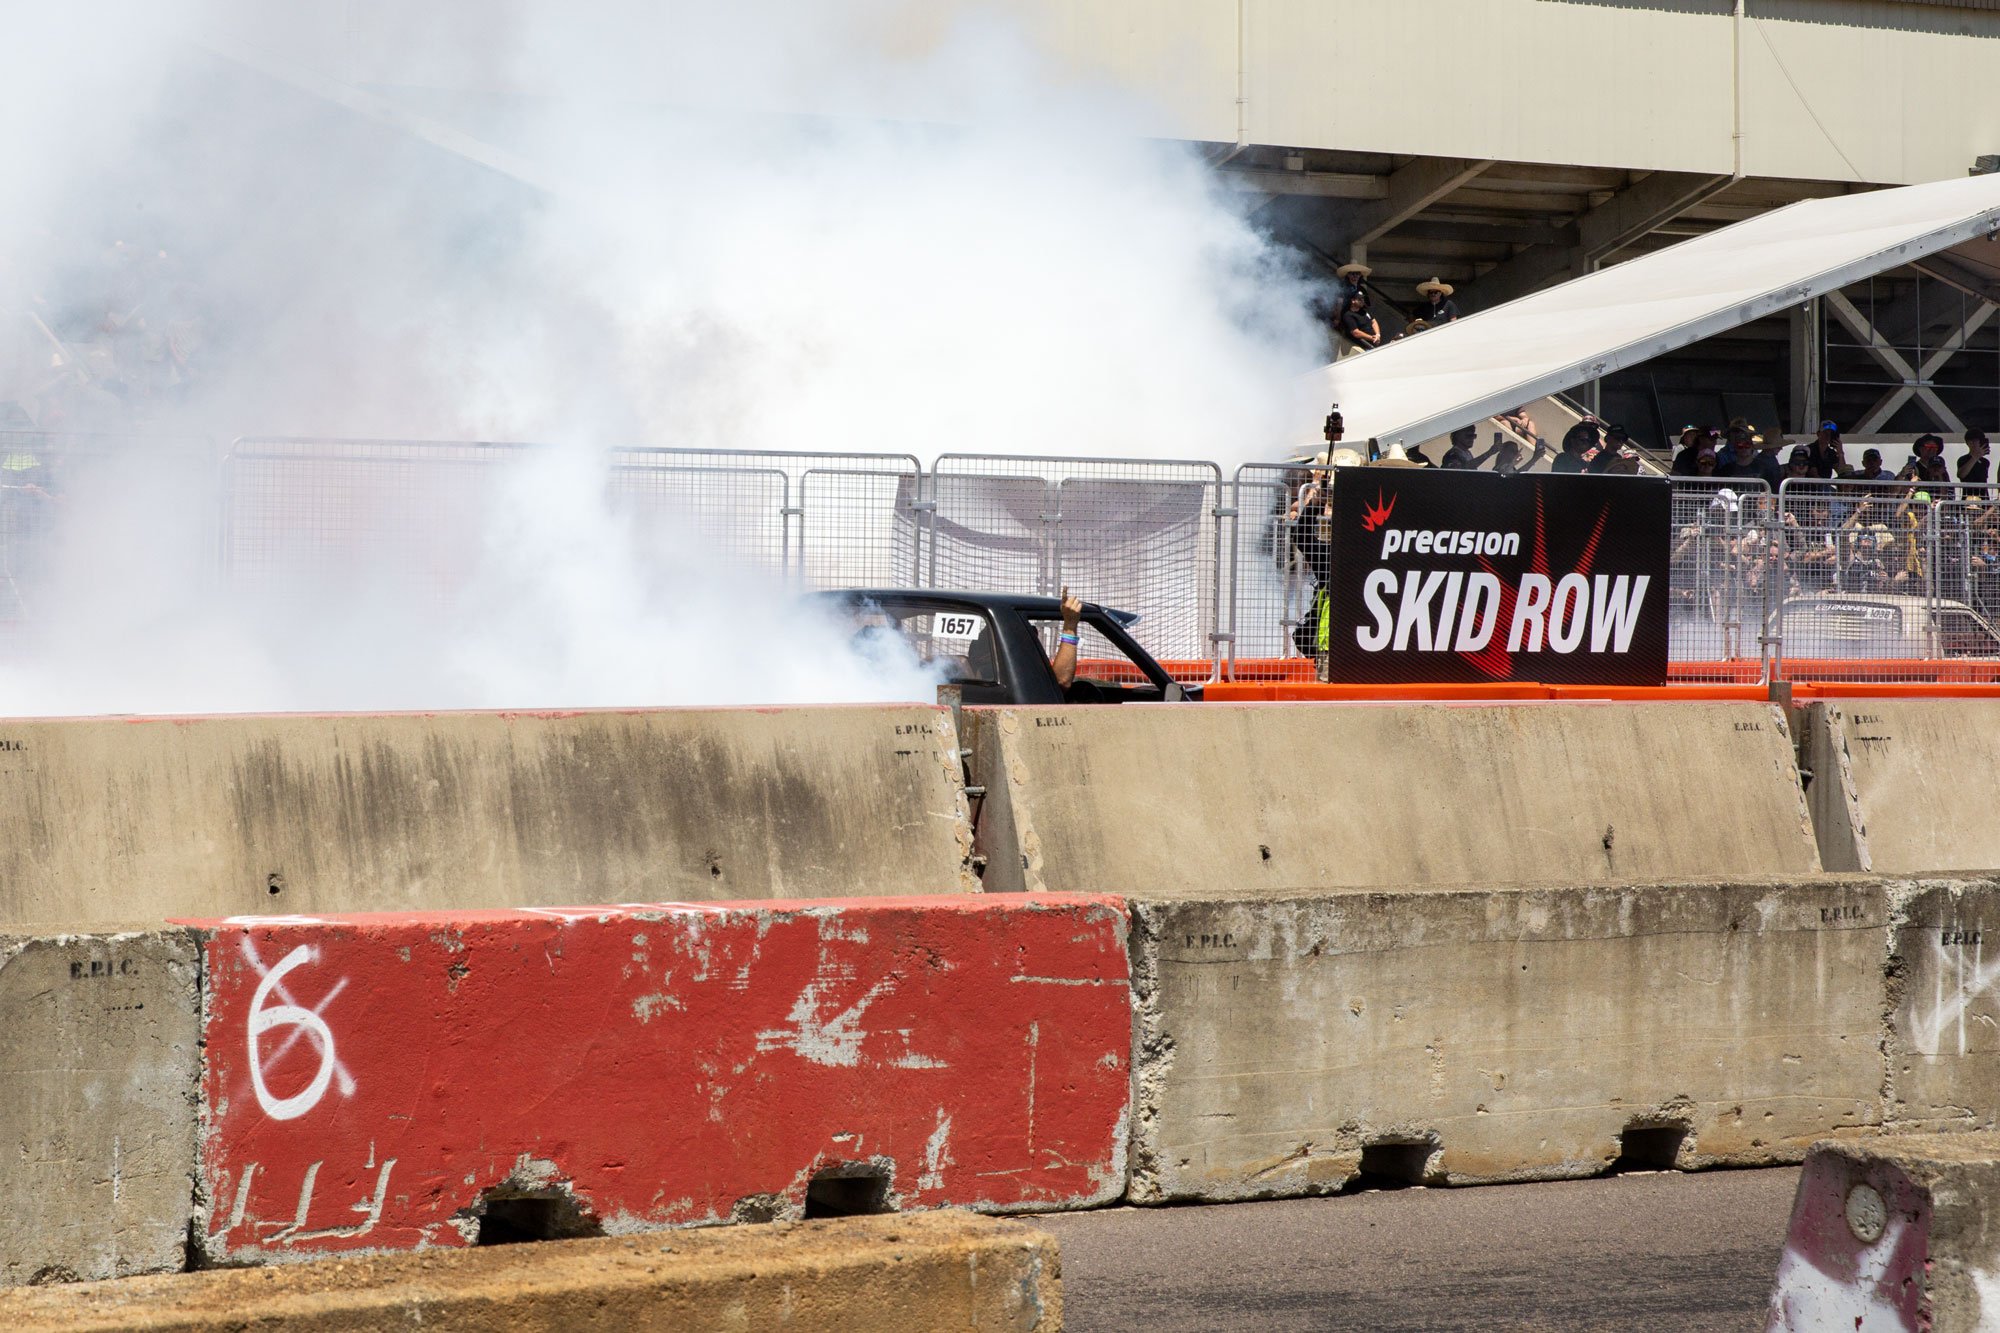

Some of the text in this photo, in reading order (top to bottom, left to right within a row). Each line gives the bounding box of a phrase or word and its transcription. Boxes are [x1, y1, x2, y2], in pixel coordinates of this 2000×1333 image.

[1381, 529, 1520, 560] precision
[1356, 568, 1651, 654] SKID ROW
[940, 617, 975, 635] 1657
[895, 724, 933, 736] E.P.I.C.
[1035, 716, 1072, 727] E.P.I.C.
[1734, 722, 1764, 732] E.P.I.C.
[1820, 905, 1865, 923] E.P.I.C.
[1941, 931, 1985, 946] E.P.I.C.
[70, 957, 139, 980] E.P.I.C.
[247, 943, 335, 1122] 6
